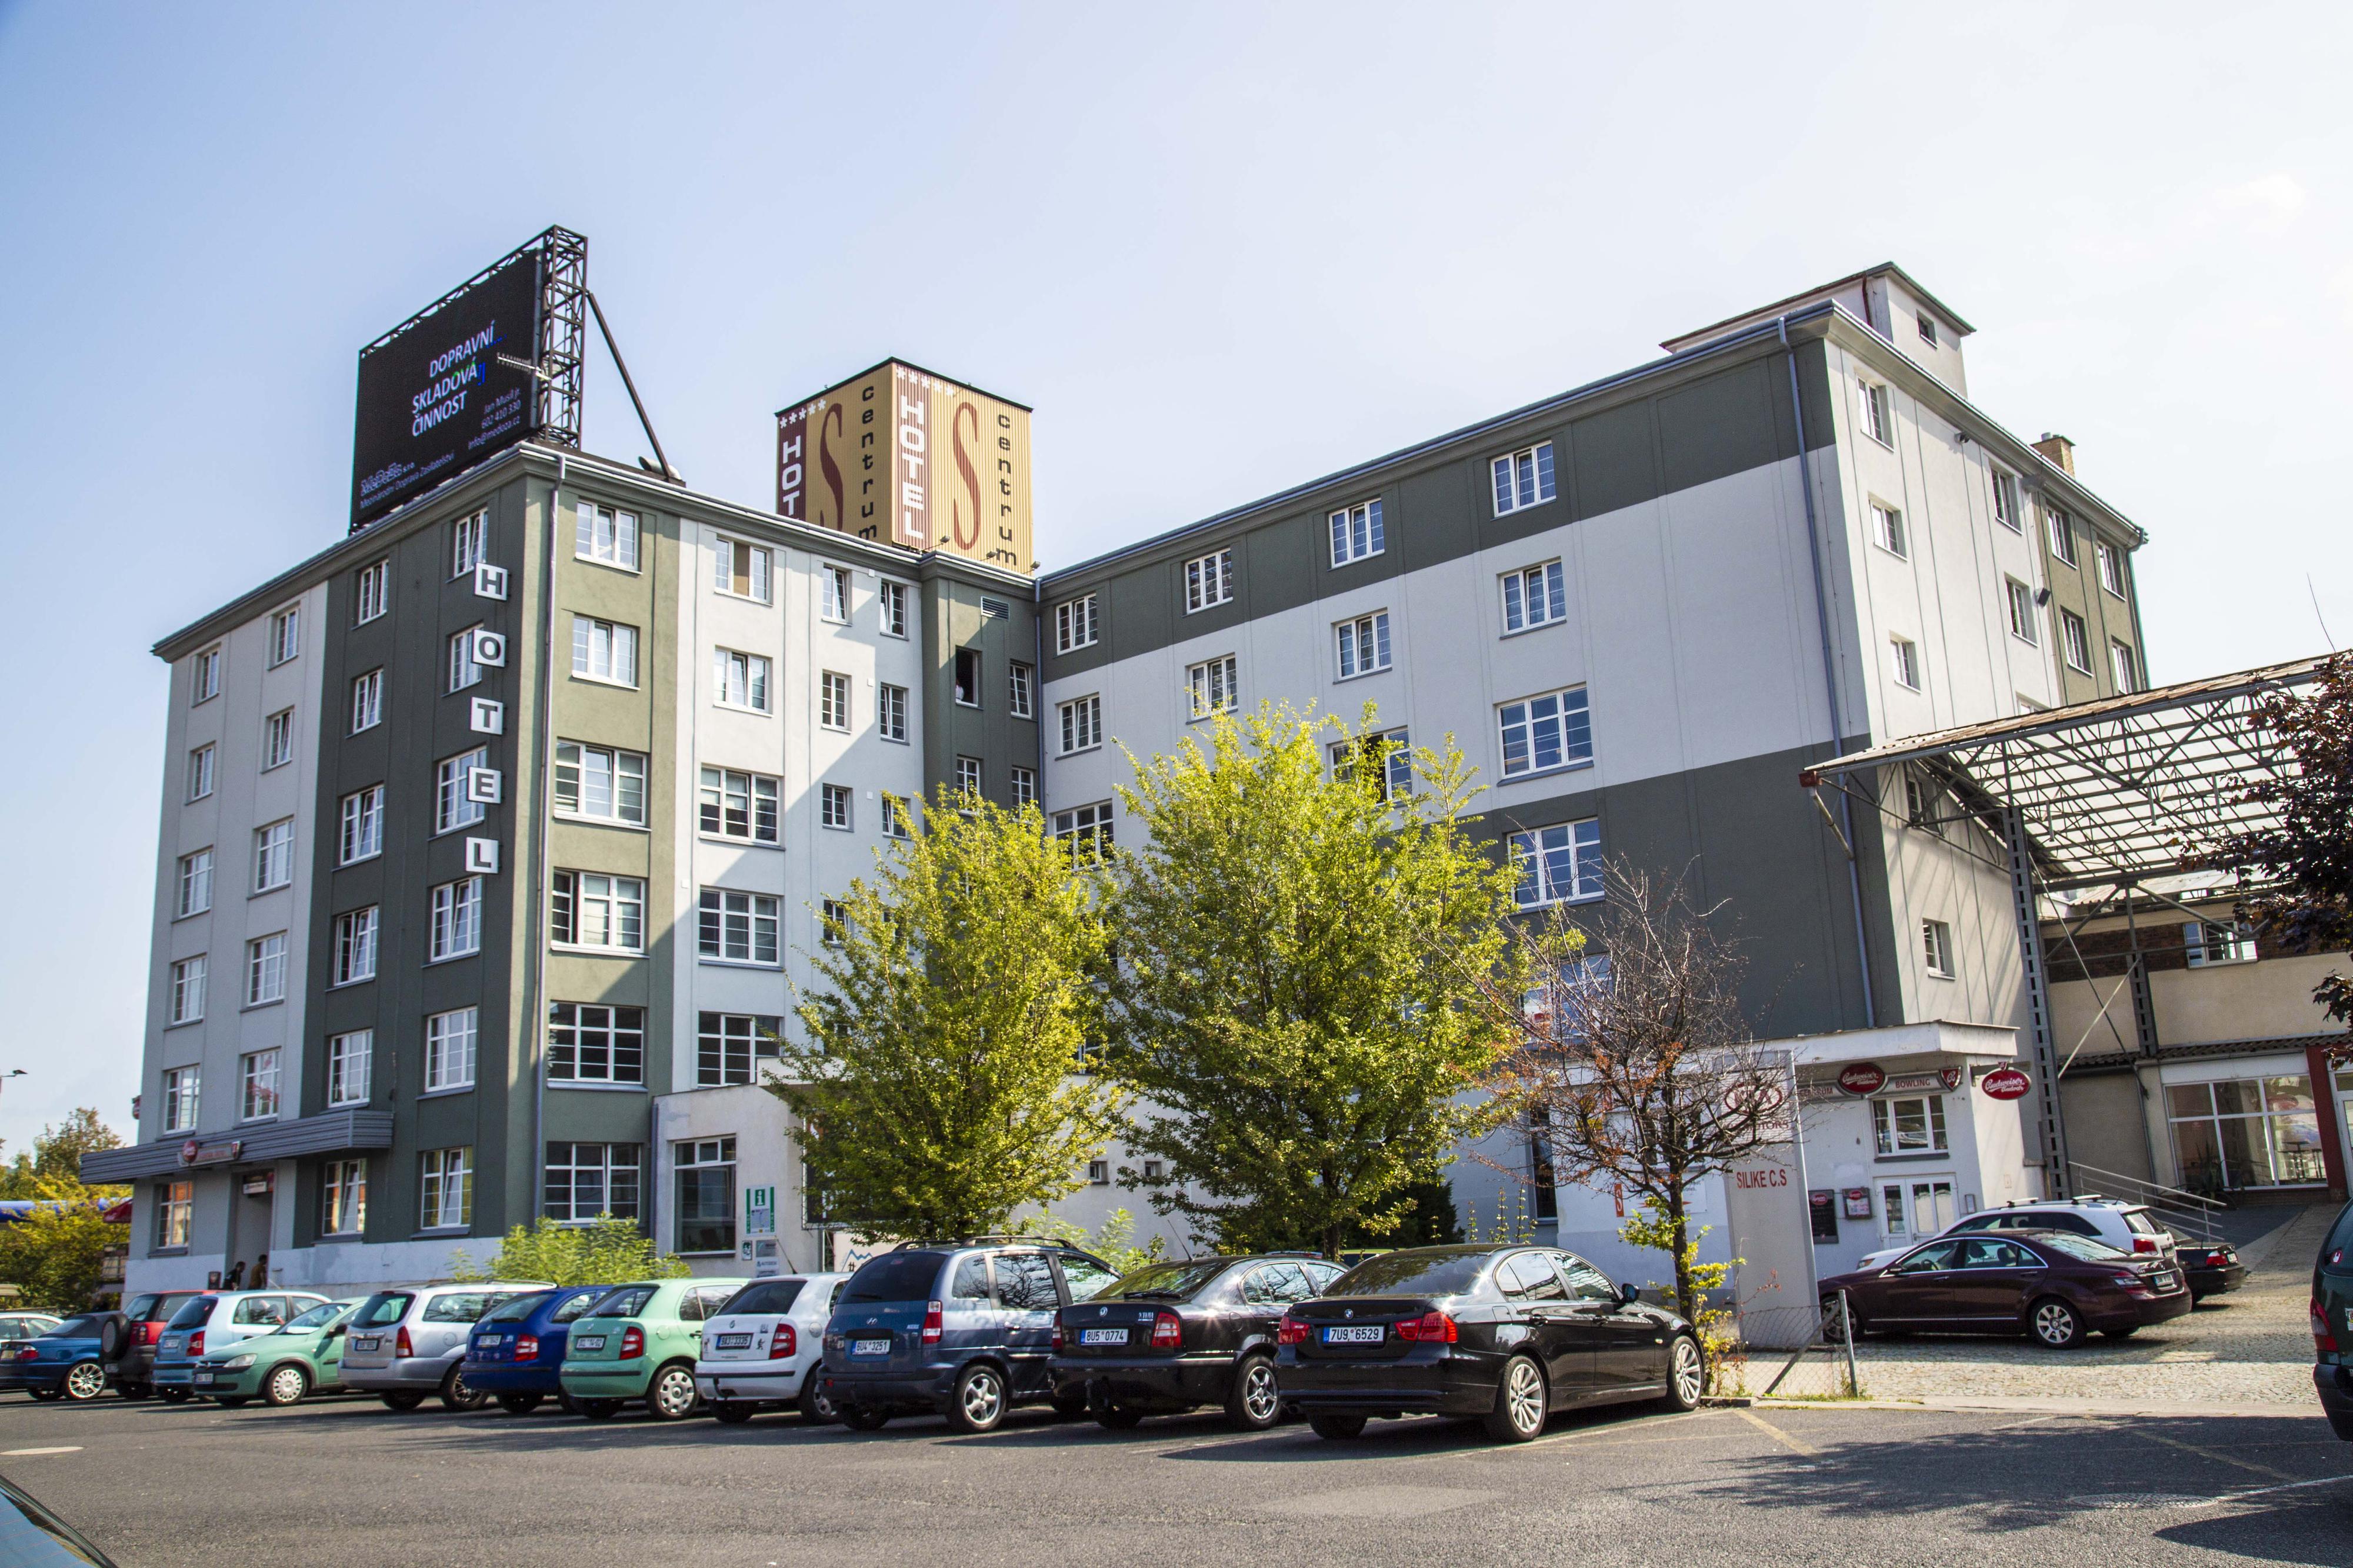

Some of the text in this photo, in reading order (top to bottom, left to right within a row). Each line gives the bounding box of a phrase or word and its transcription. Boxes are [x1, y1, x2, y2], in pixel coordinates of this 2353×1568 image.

[429, 319, 495, 378] DOPRAVNÍ
[412, 356, 477, 414] SKLADOVÁ
[412, 390, 468, 437] ČINNOST
[781, 434, 802, 521] HOT
[858, 385, 878, 541] centrum
[900, 395, 925, 540] HOTEL
[996, 413, 1018, 567] centrum
[474, 568, 503, 869] HOTEL
[1895, 1079, 1931, 1089] BOWLING
[1737, 1170, 1767, 1189] SILIKE
[871, 1340, 888, 1352] 3251
[1086, 1330, 1124, 1341] 8U5 0774
[1331, 1329, 1348, 1340] 7U9
[1355, 1328, 1379, 1340] 6529
